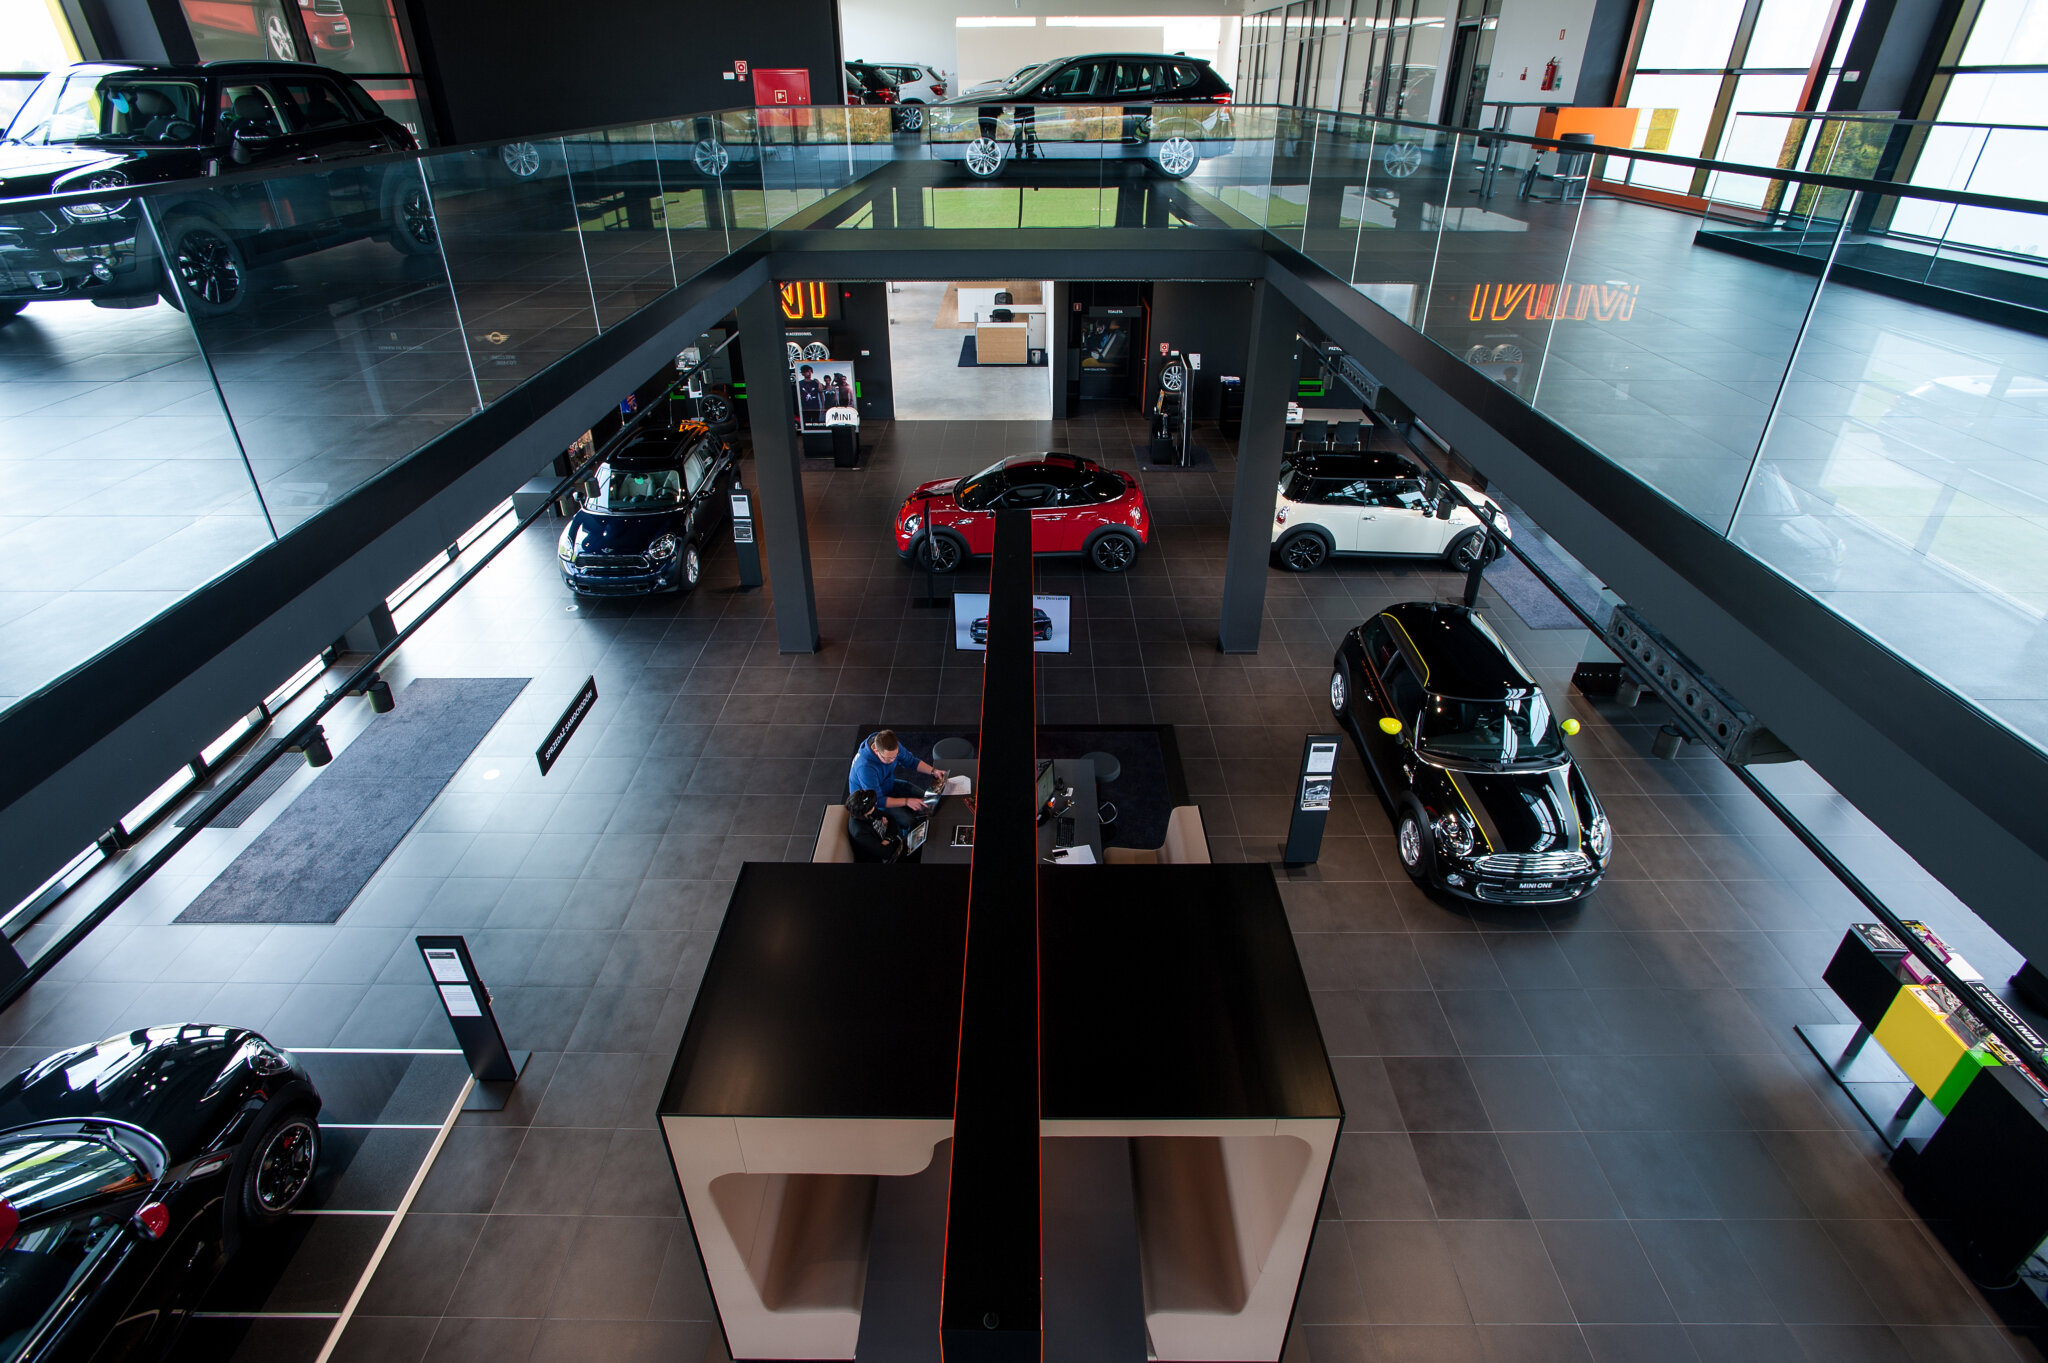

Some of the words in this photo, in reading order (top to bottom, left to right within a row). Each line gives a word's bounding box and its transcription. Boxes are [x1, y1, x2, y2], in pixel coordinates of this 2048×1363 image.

[780, 281, 827, 319] NI
[831, 412, 851, 421] MINI
[545, 727, 567, 761] SPRZEDAŻ
[565, 689, 593, 732] SAMOCHODÓW
[1982, 992, 2020, 1024] COOPER
[2015, 1025, 2043, 1045] MINI
